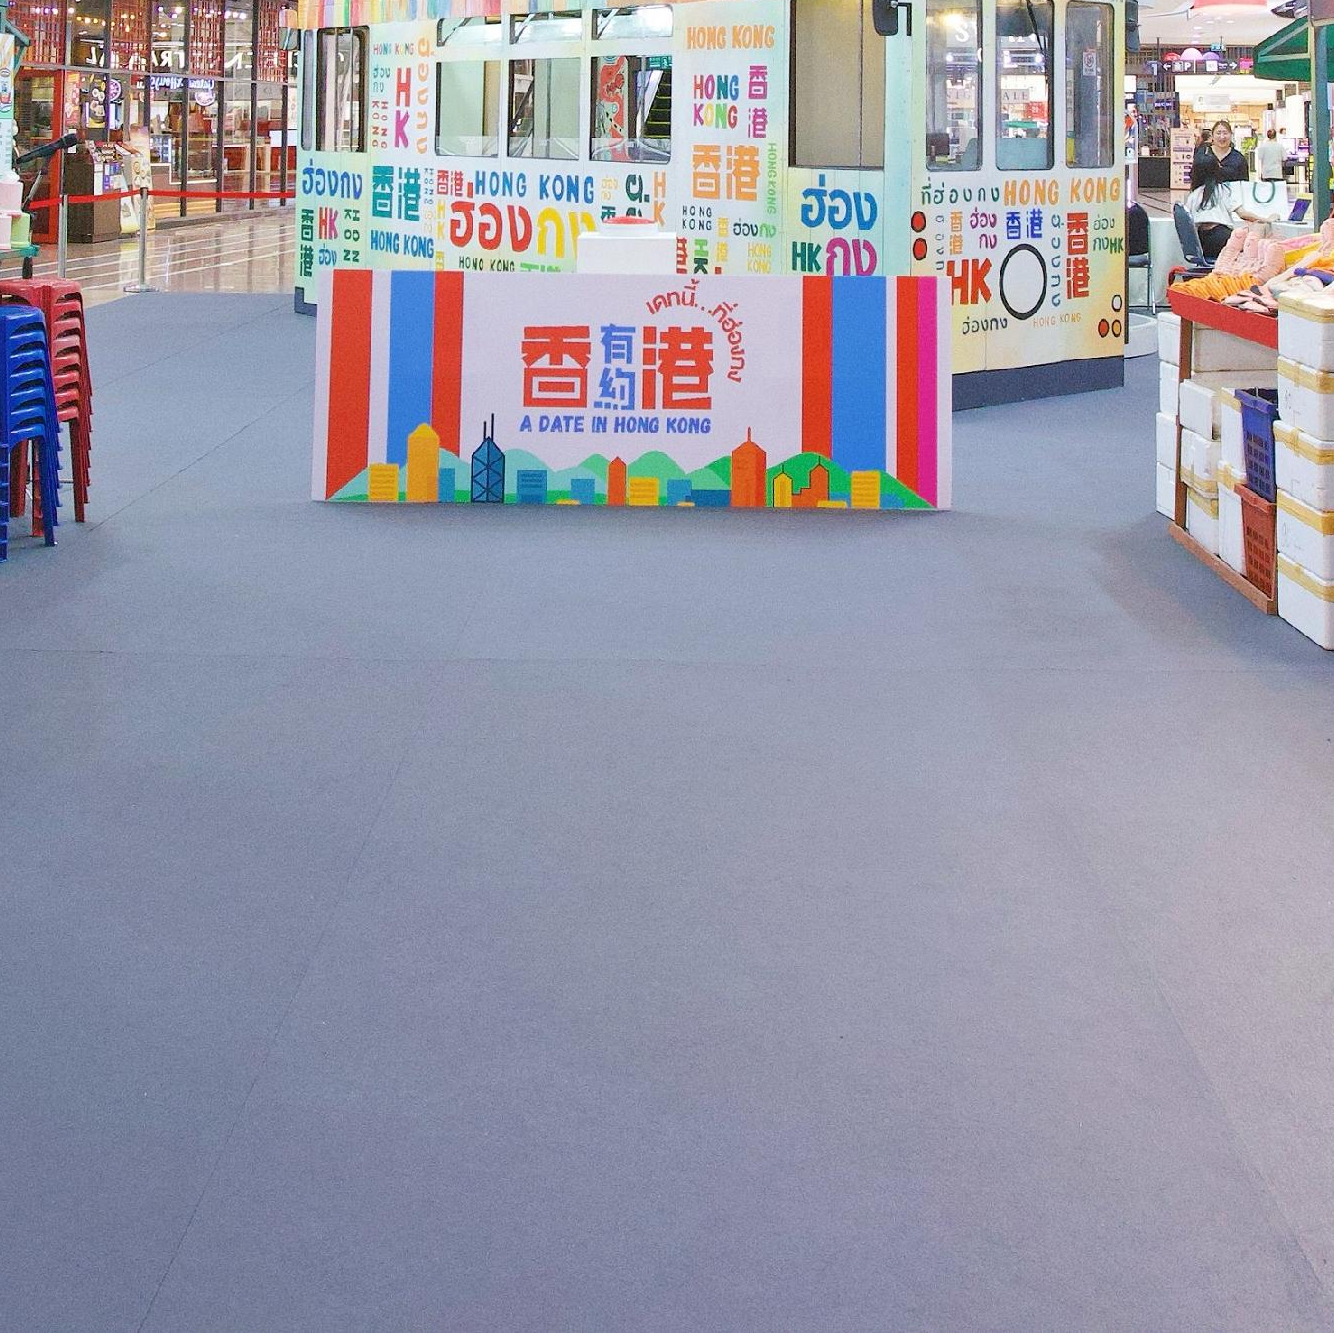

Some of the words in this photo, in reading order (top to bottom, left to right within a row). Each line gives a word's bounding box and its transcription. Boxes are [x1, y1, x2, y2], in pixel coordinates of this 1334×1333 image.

[373, 43, 392, 55] HONG
[394, 42, 414, 56] KONG
[686, 26, 727, 50] HONG
[731, 25, 775, 49] KONG
[693, 74, 740, 101] HONG
[748, 65, 768, 139] 香港
[693, 103, 738, 129] KONG
[301, 158, 363, 201] ฮ่องกง
[436, 169, 464, 197] 香港
[475, 170, 527, 198] HONG
[539, 174, 594, 204] KONG
[692, 144, 760, 202] 香港
[372, 166, 421, 222] 香港
[801, 174, 877, 231] ฮ่อง
[1003, 179, 1059, 207] HONG
[1070, 176, 1121, 204] KONG
[318, 206, 338, 240] HK
[682, 205, 712, 218] HONG
[682, 218, 712, 231] KONG
[969, 207, 997, 229] ฮ่อง
[1005, 208, 1043, 240] 香港
[370, 229, 400, 255] HONG
[403, 232, 434, 259] KONG
[979, 233, 997, 249] กง
[1066, 212, 1090, 300] 香港
[459, 256, 484, 270] HONG
[792, 241, 821, 273] HK
[826, 237, 878, 276] กง
[947, 258, 992, 306] HK
[1033, 316, 1056, 328] HONG
[1059, 313, 1082, 324] KONG
[519, 415, 532, 432] A
[539, 415, 585, 433] DATE
[591, 416, 607, 433] IN
[613, 416, 659, 434] HONG
[667, 416, 711, 434] KONG
